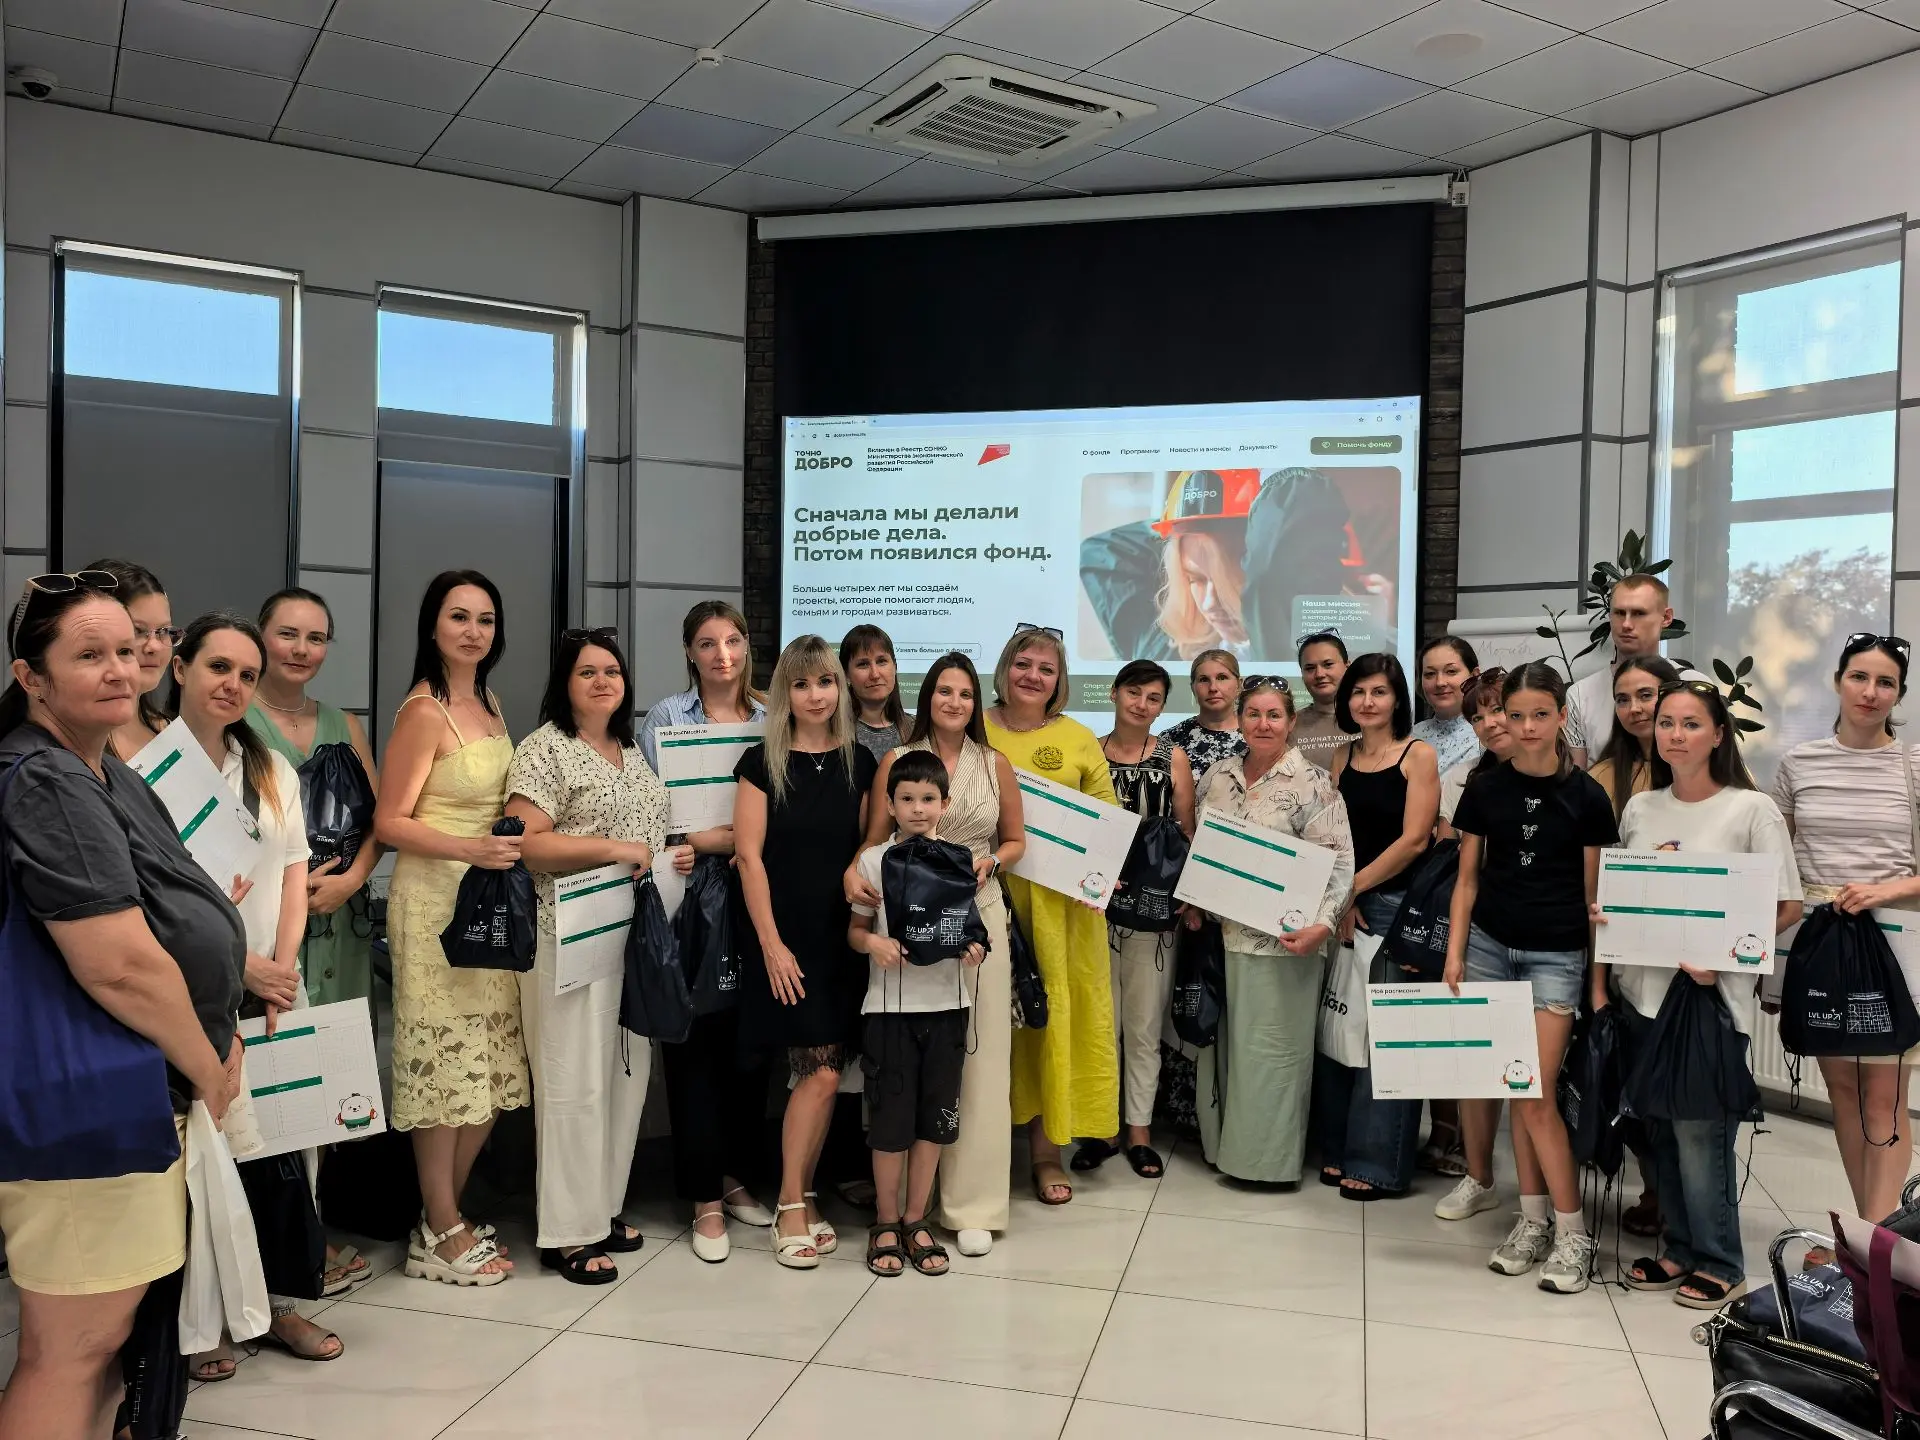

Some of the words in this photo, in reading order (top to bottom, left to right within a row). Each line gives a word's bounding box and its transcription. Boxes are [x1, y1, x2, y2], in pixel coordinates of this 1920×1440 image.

[794, 456, 853, 471] ДОБРО
[1184, 490, 1217, 501] ДОБРО
[794, 507, 888, 523] Сначала
[893, 507, 928, 521] мы
[934, 505, 1019, 522] делали
[793, 524, 881, 545] добрые
[886, 527, 947, 543] дела.
[794, 546, 864, 562] Потом
[870, 546, 977, 561] появился
[983, 543, 1052, 563] фонд.
[792, 585, 832, 593] Больше
[878, 584, 896, 592] лет
[897, 584, 913, 592] мы
[915, 583, 959, 593] создаём
[792, 597, 838, 607] проекты,
[839, 596, 882, 605] которые
[884, 596, 935, 604] помогают
[937, 596, 975, 606] людям,
[792, 608, 830, 617] семьям
[832, 608, 839, 616] и
[841, 608, 884, 618] городам
[886, 608, 952, 618] развиваться.
[1309, 735, 1332, 743] WHAT
[1808, 1011, 1821, 1019] LVL
[1822, 1012, 1833, 1020] UP
[1809, 1278, 1825, 1289] UP
